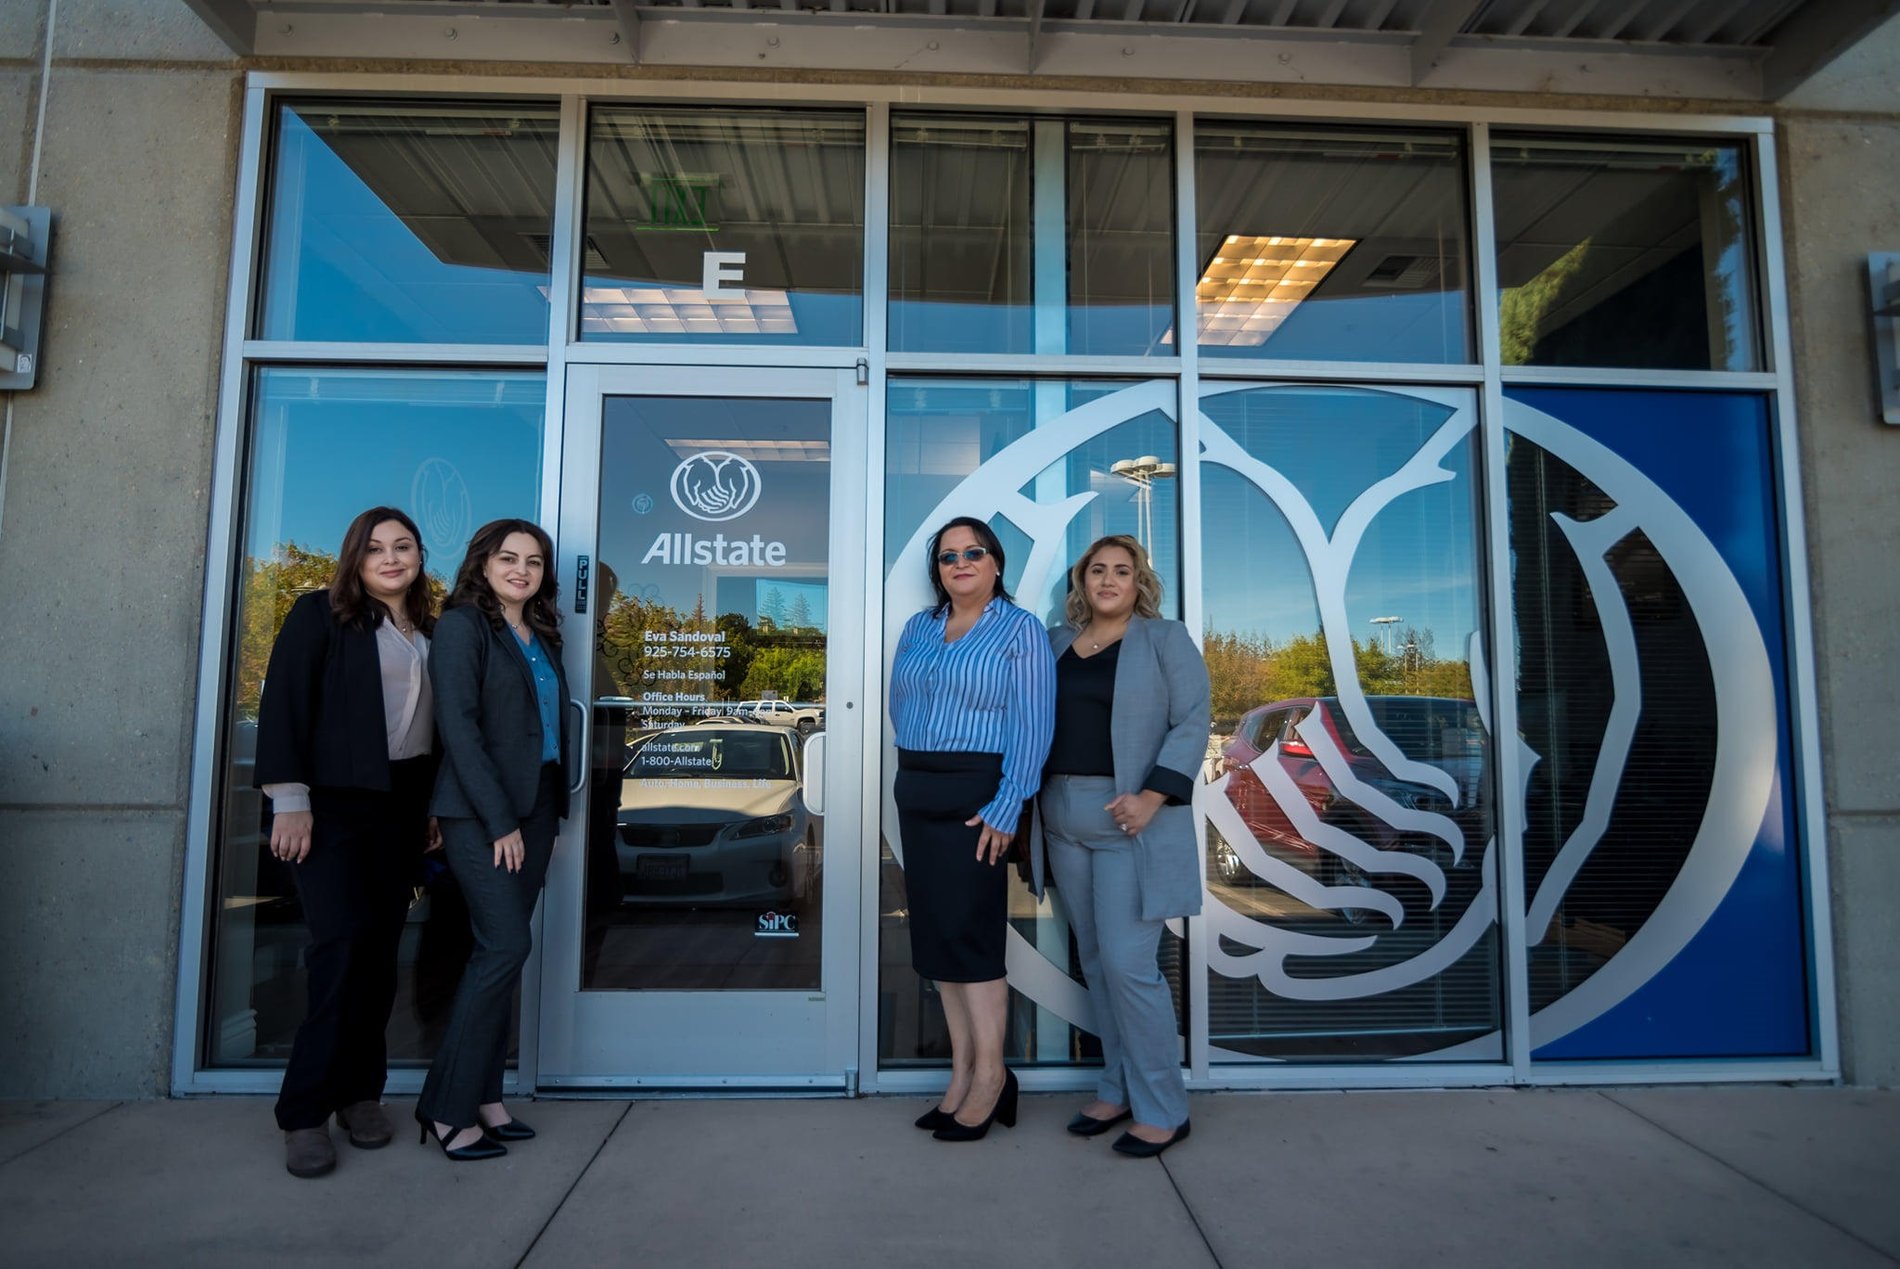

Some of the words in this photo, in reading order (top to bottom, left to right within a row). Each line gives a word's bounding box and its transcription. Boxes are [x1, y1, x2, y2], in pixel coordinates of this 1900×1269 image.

[703, 251, 746, 300] E
[641, 532, 787, 567] Allstate
[578, 560, 588, 599] PULL
[644, 631, 667, 642] Eva
[670, 630, 726, 642] Sandoval
[643, 646, 731, 658] 925-754-6575
[643, 670, 656, 680] Se
[657, 670, 686, 680] Habla
[688, 669, 726, 681] Español
[642, 691, 673, 702] Office
[675, 692, 706, 702] Hours
[642, 706, 683, 717] Monday
[692, 706, 722, 717] Friday
[642, 720, 686, 731] Saturday
[641, 742, 702, 753] allstate.com
[641, 756, 713, 767] 1-800-Allstate
